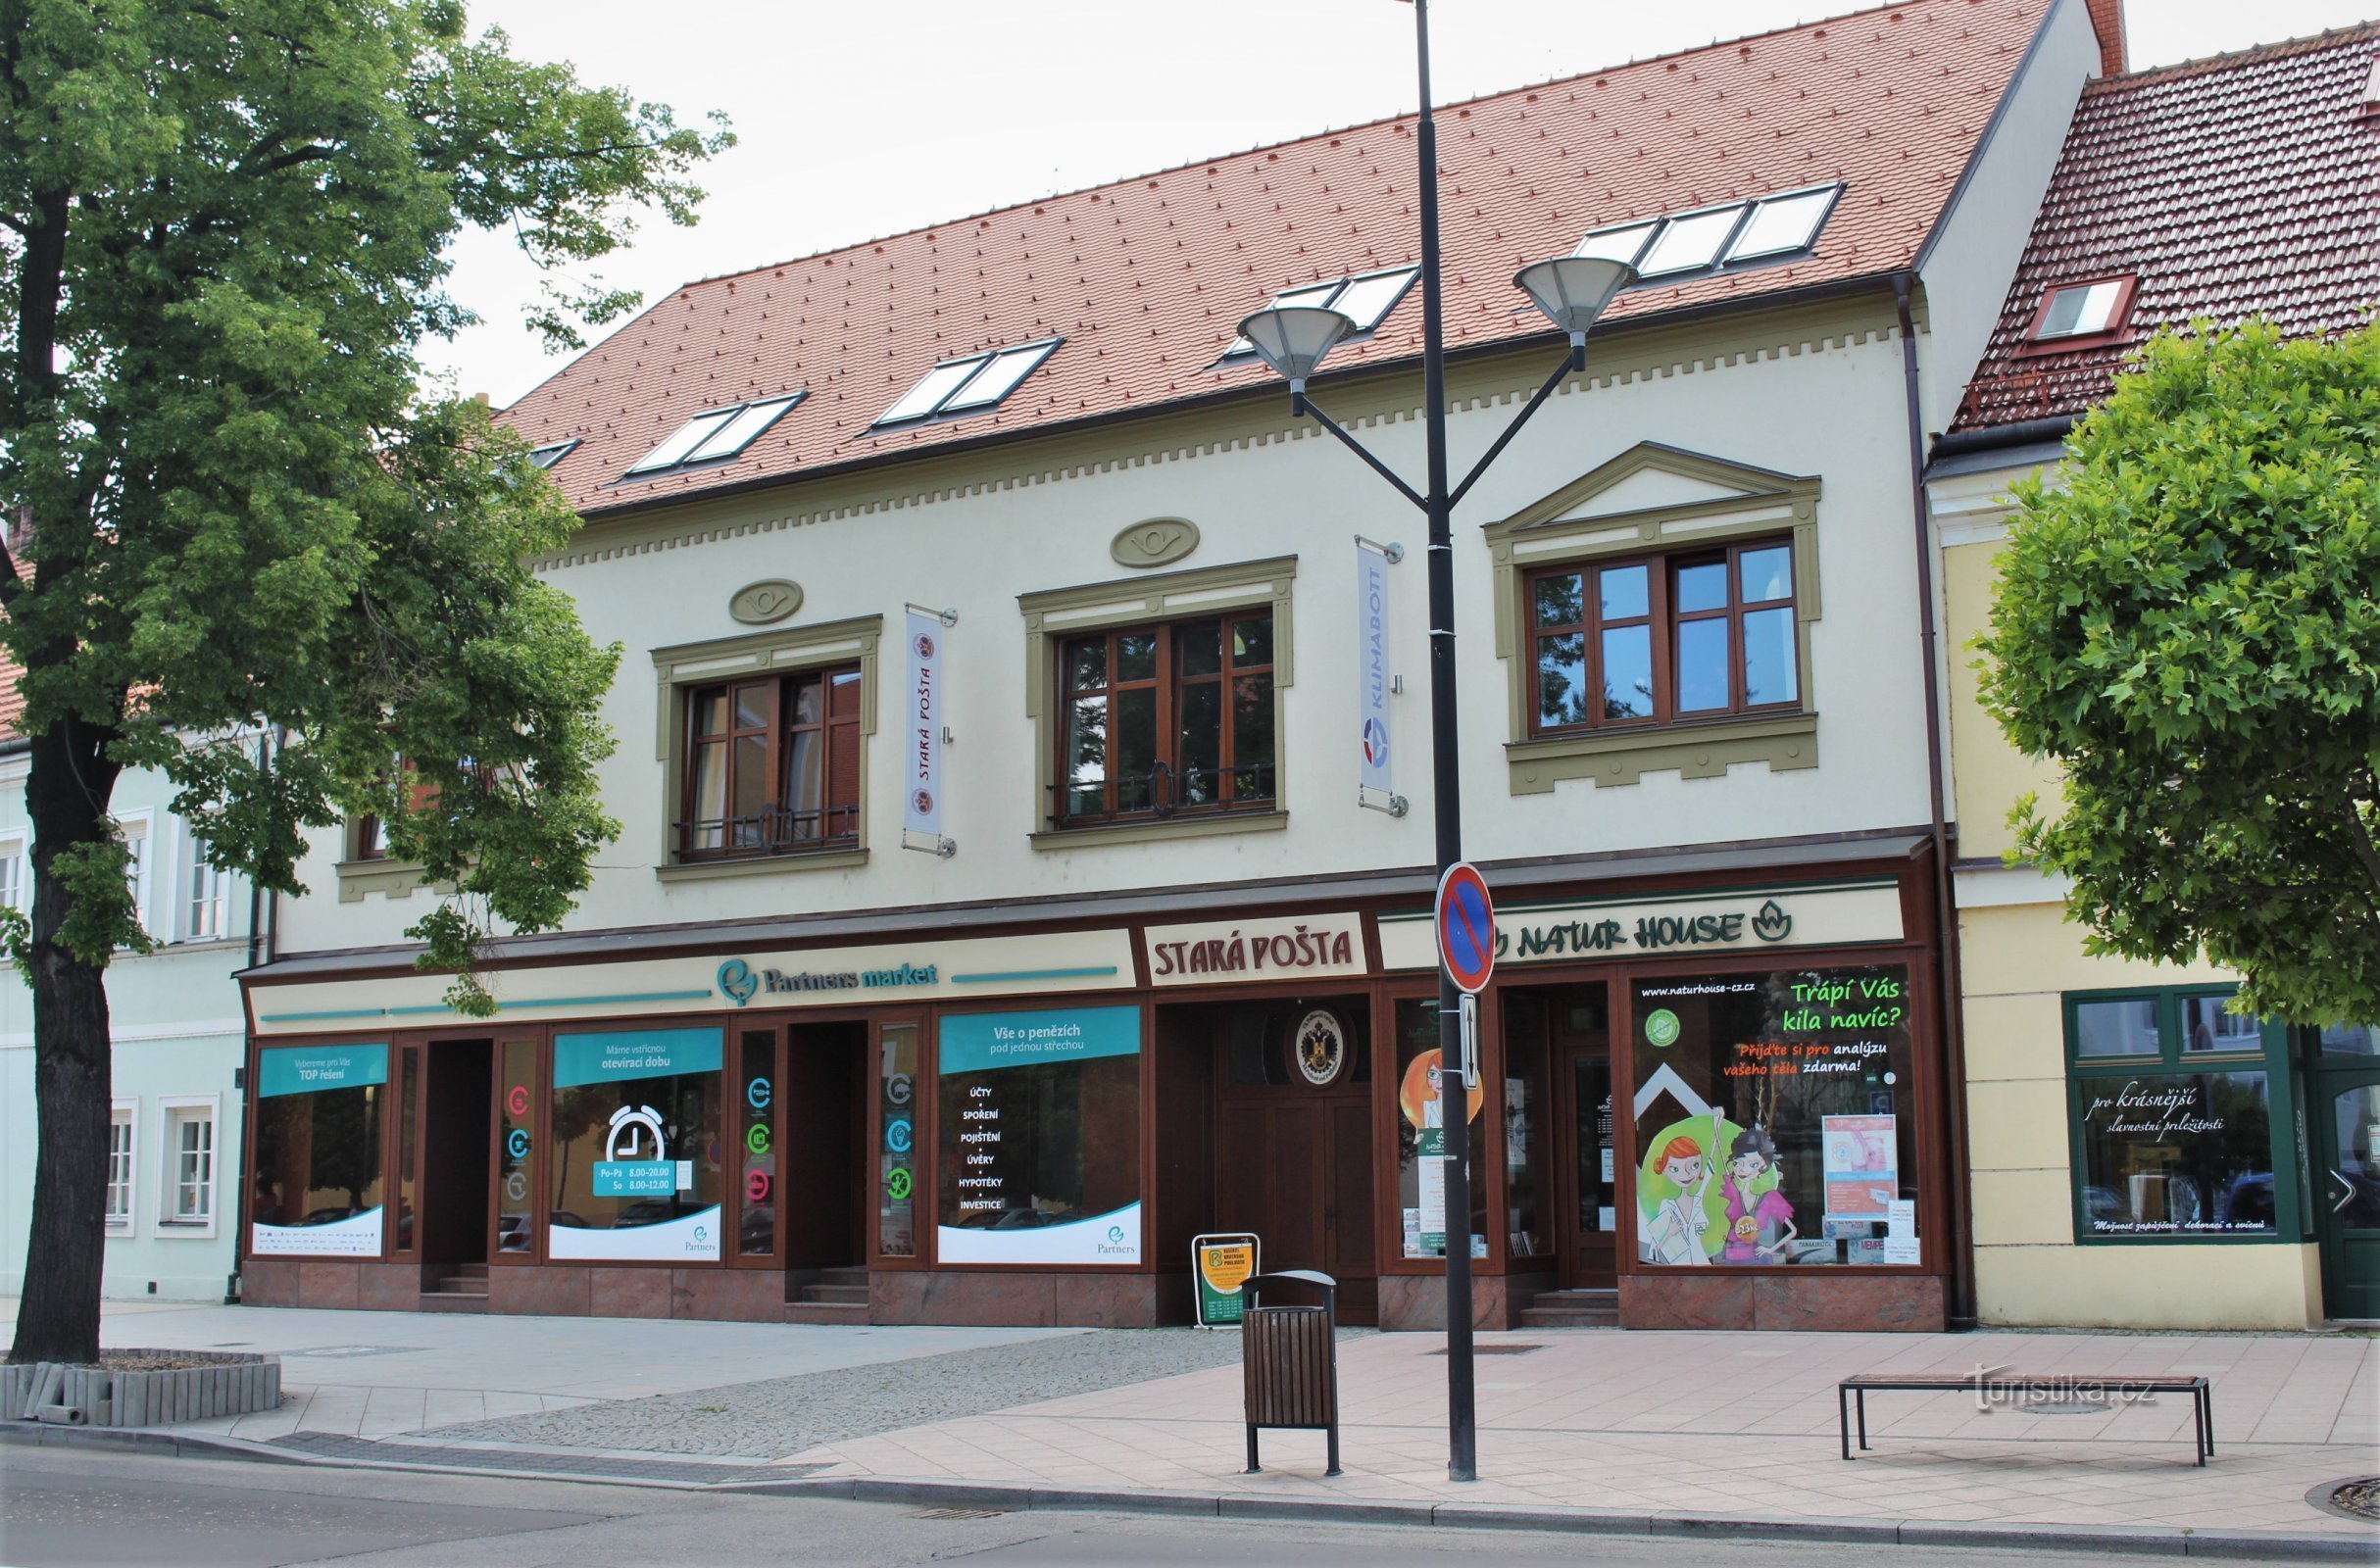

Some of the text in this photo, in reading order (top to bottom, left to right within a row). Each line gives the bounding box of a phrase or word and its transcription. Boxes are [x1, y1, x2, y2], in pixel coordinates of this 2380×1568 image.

[1369, 566, 1383, 710] KLIMABOTT
[917, 667, 930, 781] STARÁ POŠTA
[1516, 912, 1746, 957] NATUR HOUSE
[1154, 924, 1353, 975] STARÁ POŠTA
[761, 962, 939, 994] Partners market
[1641, 982, 1756, 997] www.naturhouse-cz.cz
[1790, 977, 1900, 1007] Trápí Vás
[1783, 1006, 1902, 1032] kila navíc?
[993, 1023, 1081, 1042] Vše o penězích
[990, 1039, 1084, 1055] pod jednou střechou
[1739, 1040, 1888, 1061] Přijďte si pro analýzu
[294, 1057, 351, 1070] Vybereme pro Vás
[601, 1055, 670, 1069] otevírací dobu
[1723, 1059, 1861, 1077] vašeho těla zdarma!
[299, 1068, 345, 1080] TOP řešení
[969, 1086, 993, 1098] ÚČTY
[2083, 1080, 2198, 1122] pro krásnější
[963, 1108, 999, 1120] SPOŘENÍ
[2106, 1113, 2162, 1133] slavnostní
[960, 1131, 1001, 1145] POJIŠTĚNÍ
[967, 1153, 994, 1165] ÚVĚRY
[628, 1167, 669, 1178] 8.00-20.00
[613, 1180, 669, 1191] So 8.00-12.00
[958, 1176, 1003, 1188] HYPOTÉKY
[960, 1200, 1002, 1210] INVESTICE
[2093, 1219, 2133, 1233] Možnost
[685, 1242, 716, 1251] Partners
[1097, 1243, 1135, 1254] Partners
